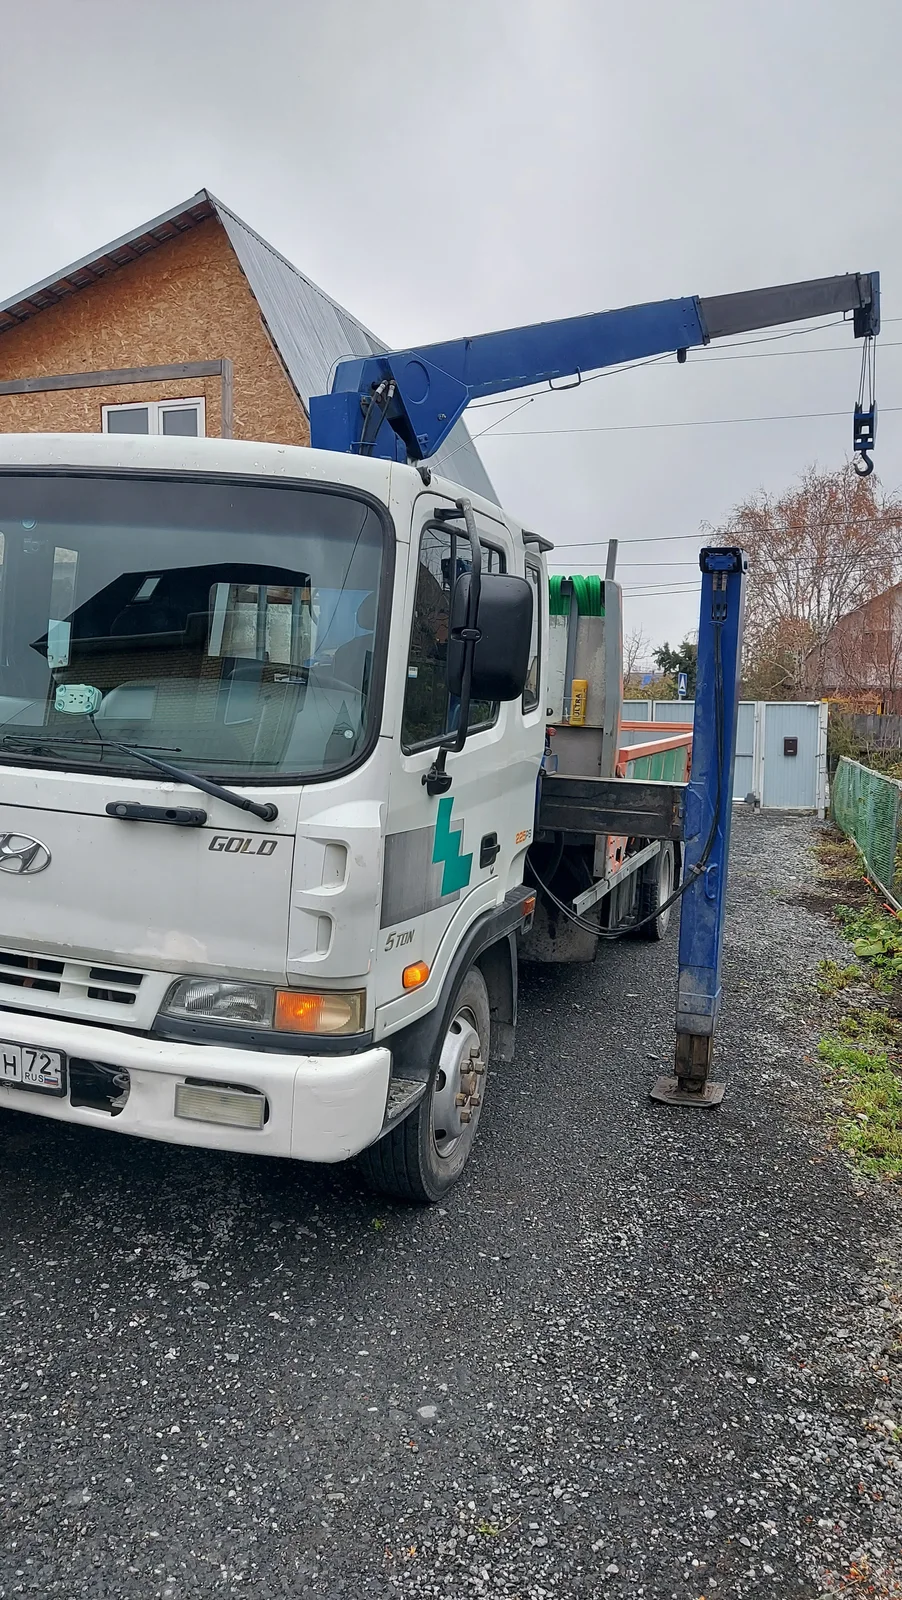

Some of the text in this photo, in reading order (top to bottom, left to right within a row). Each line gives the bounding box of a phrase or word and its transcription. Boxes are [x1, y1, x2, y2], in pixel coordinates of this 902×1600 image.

[574, 693, 582, 718] ULTRA
[208, 835, 278, 856] GOLD
[384, 929, 415, 952] 5 TON
[25, 1050, 52, 1076] 72
[24, 1072, 44, 1083] RUS
